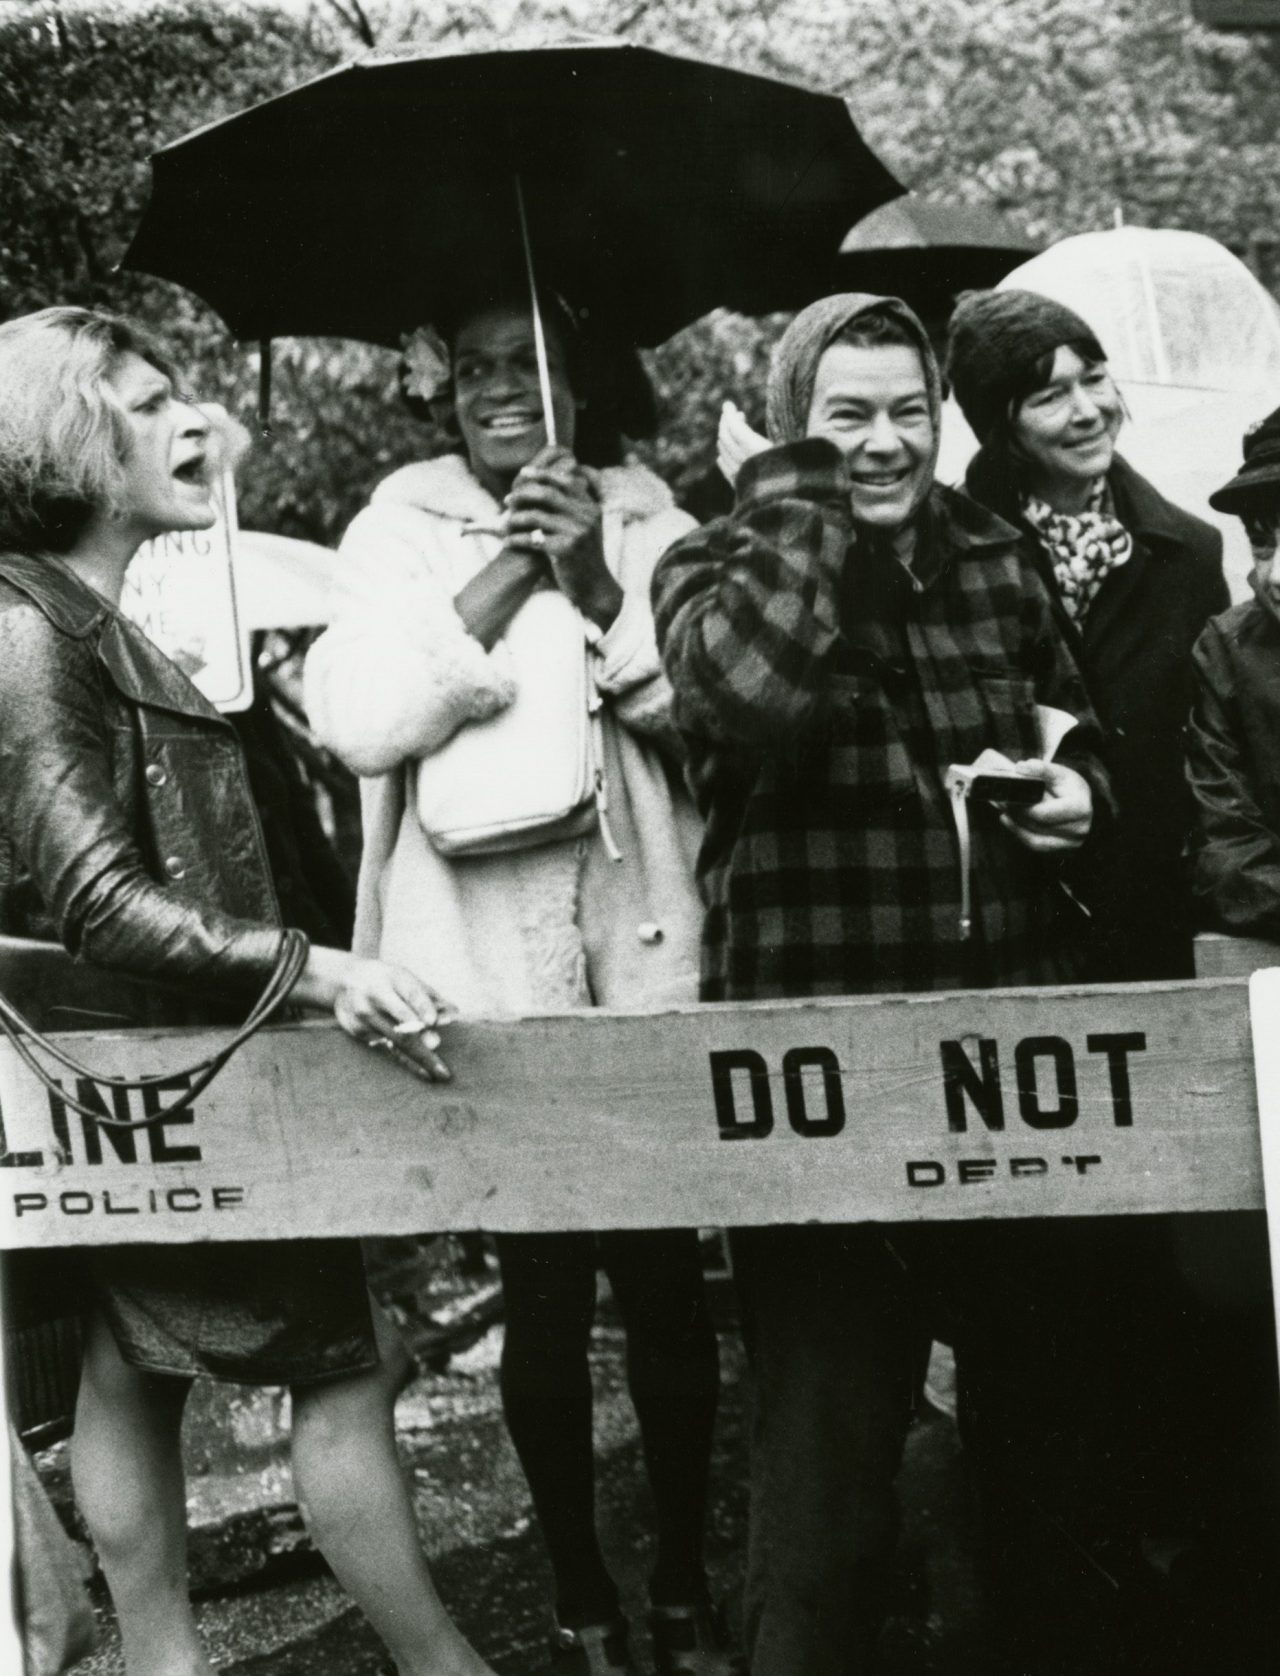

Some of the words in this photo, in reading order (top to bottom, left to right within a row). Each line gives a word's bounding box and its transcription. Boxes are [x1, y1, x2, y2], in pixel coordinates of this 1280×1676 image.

[139, 531, 211, 559] ING
[125, 572, 167, 598] NY
[0, 1074, 202, 1168] LINE
[709, 1046, 846, 1141] DO
[939, 1032, 1146, 1133] NOT
[14, 1187, 244, 1217] POLICE
